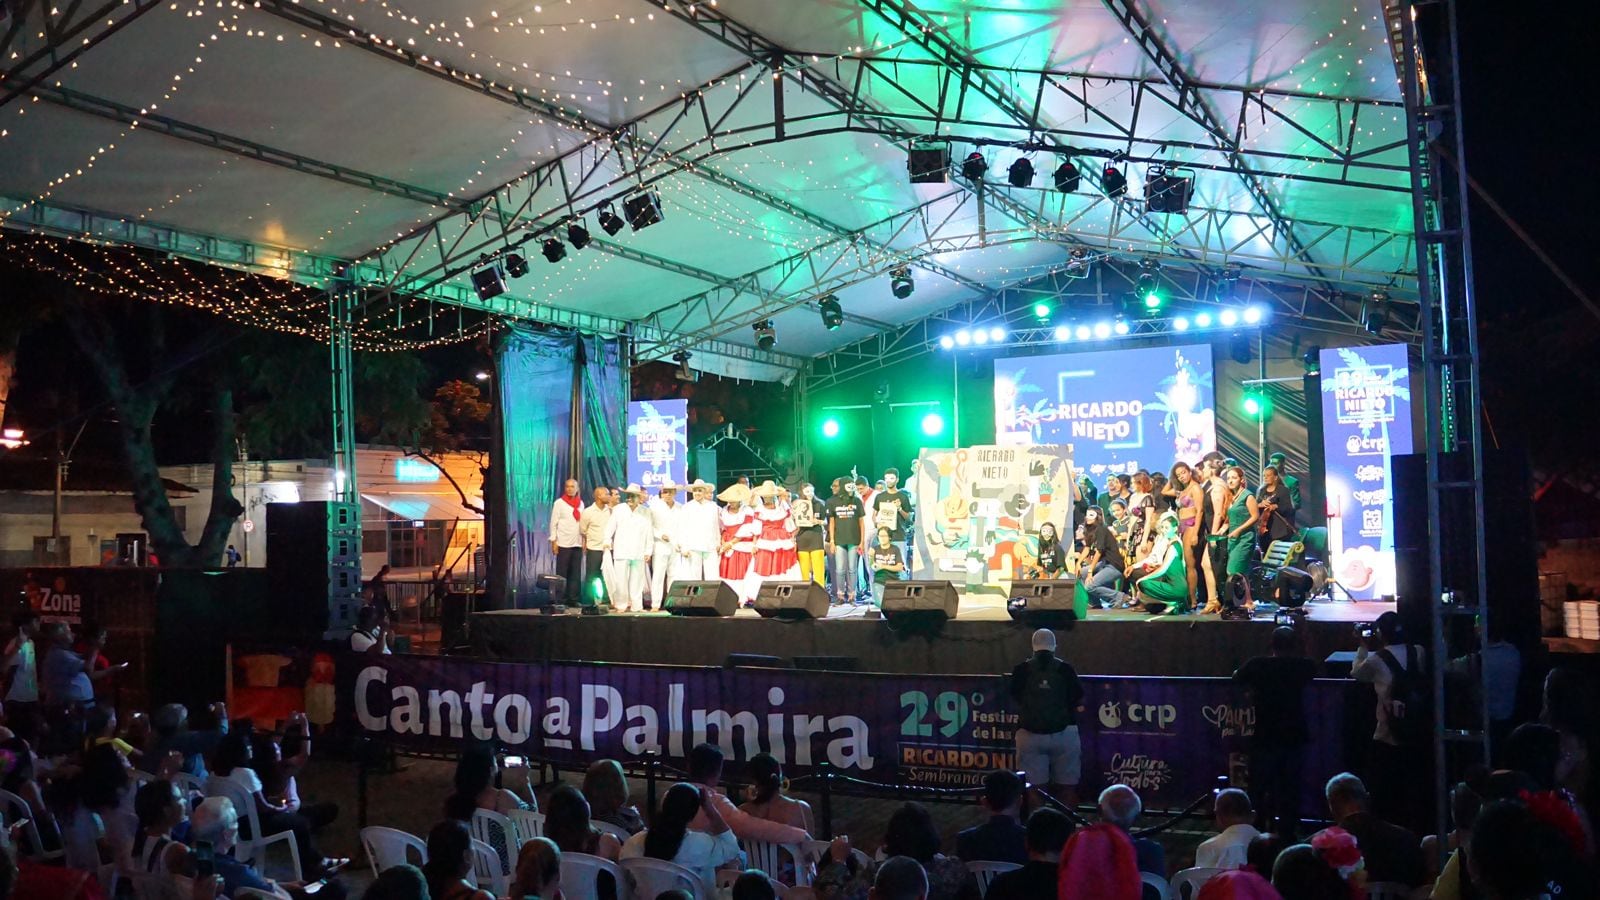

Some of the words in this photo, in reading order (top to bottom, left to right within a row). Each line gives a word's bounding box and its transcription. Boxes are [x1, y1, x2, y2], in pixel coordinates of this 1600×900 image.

[1335, 386, 1394, 400] RICARDO
[1059, 400, 1143, 420] RICARDO
[1344, 398, 1386, 411] NIETO
[1072, 421, 1130, 441] NIETO
[982, 466, 1009, 479] NIETO
[40, 587, 81, 612] Zona
[354, 666, 532, 744] Canto
[543, 696, 573, 749] a
[580, 683, 874, 771] Palmira
[1127, 703, 1177, 729] crp
[972, 726, 989, 740] de
[903, 747, 988, 768] RICARDO
